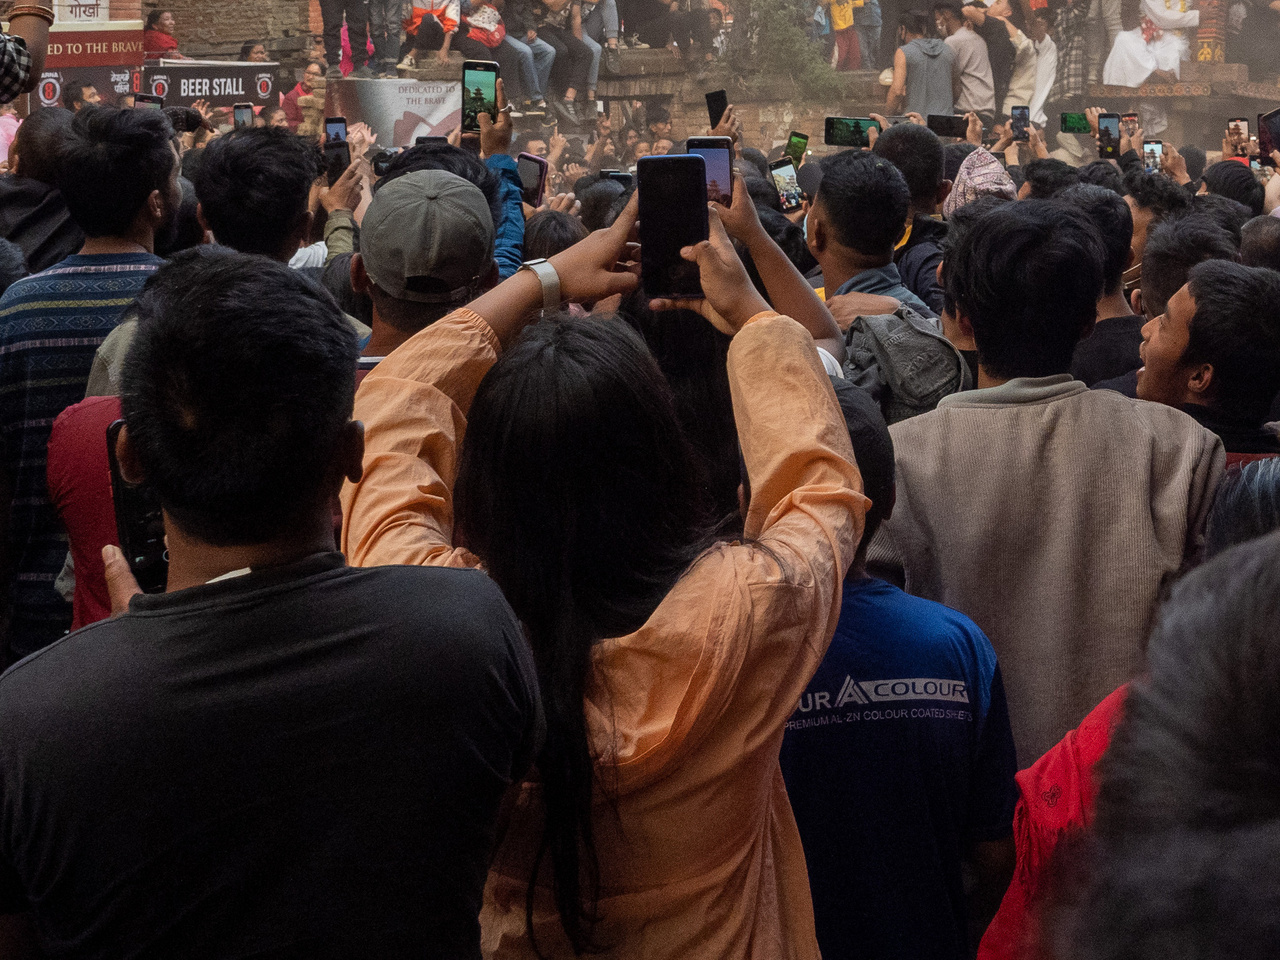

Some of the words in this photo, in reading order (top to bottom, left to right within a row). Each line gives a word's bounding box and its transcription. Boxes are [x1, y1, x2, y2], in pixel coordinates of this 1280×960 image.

[47, 43, 63, 55] ED
[66, 43, 82, 55] TO
[85, 42, 108, 54] THE
[112, 41, 144, 53] BRAVE
[44, 82, 53, 100] 8
[156, 82, 163, 96] 8
[180, 79, 210, 96] BEER
[213, 78, 245, 96] STALL
[261, 80, 267, 93] 8
[398, 86, 442, 94] DEDICATED
[445, 85, 456, 93] TO
[406, 97, 421, 105] THE
[424, 97, 446, 105] BRAVE
[873, 681, 966, 698] COLOUR
[784, 716, 829, 731] PREMIUM
[863, 708, 908, 721] COLOUR
[911, 708, 945, 719] COATED
